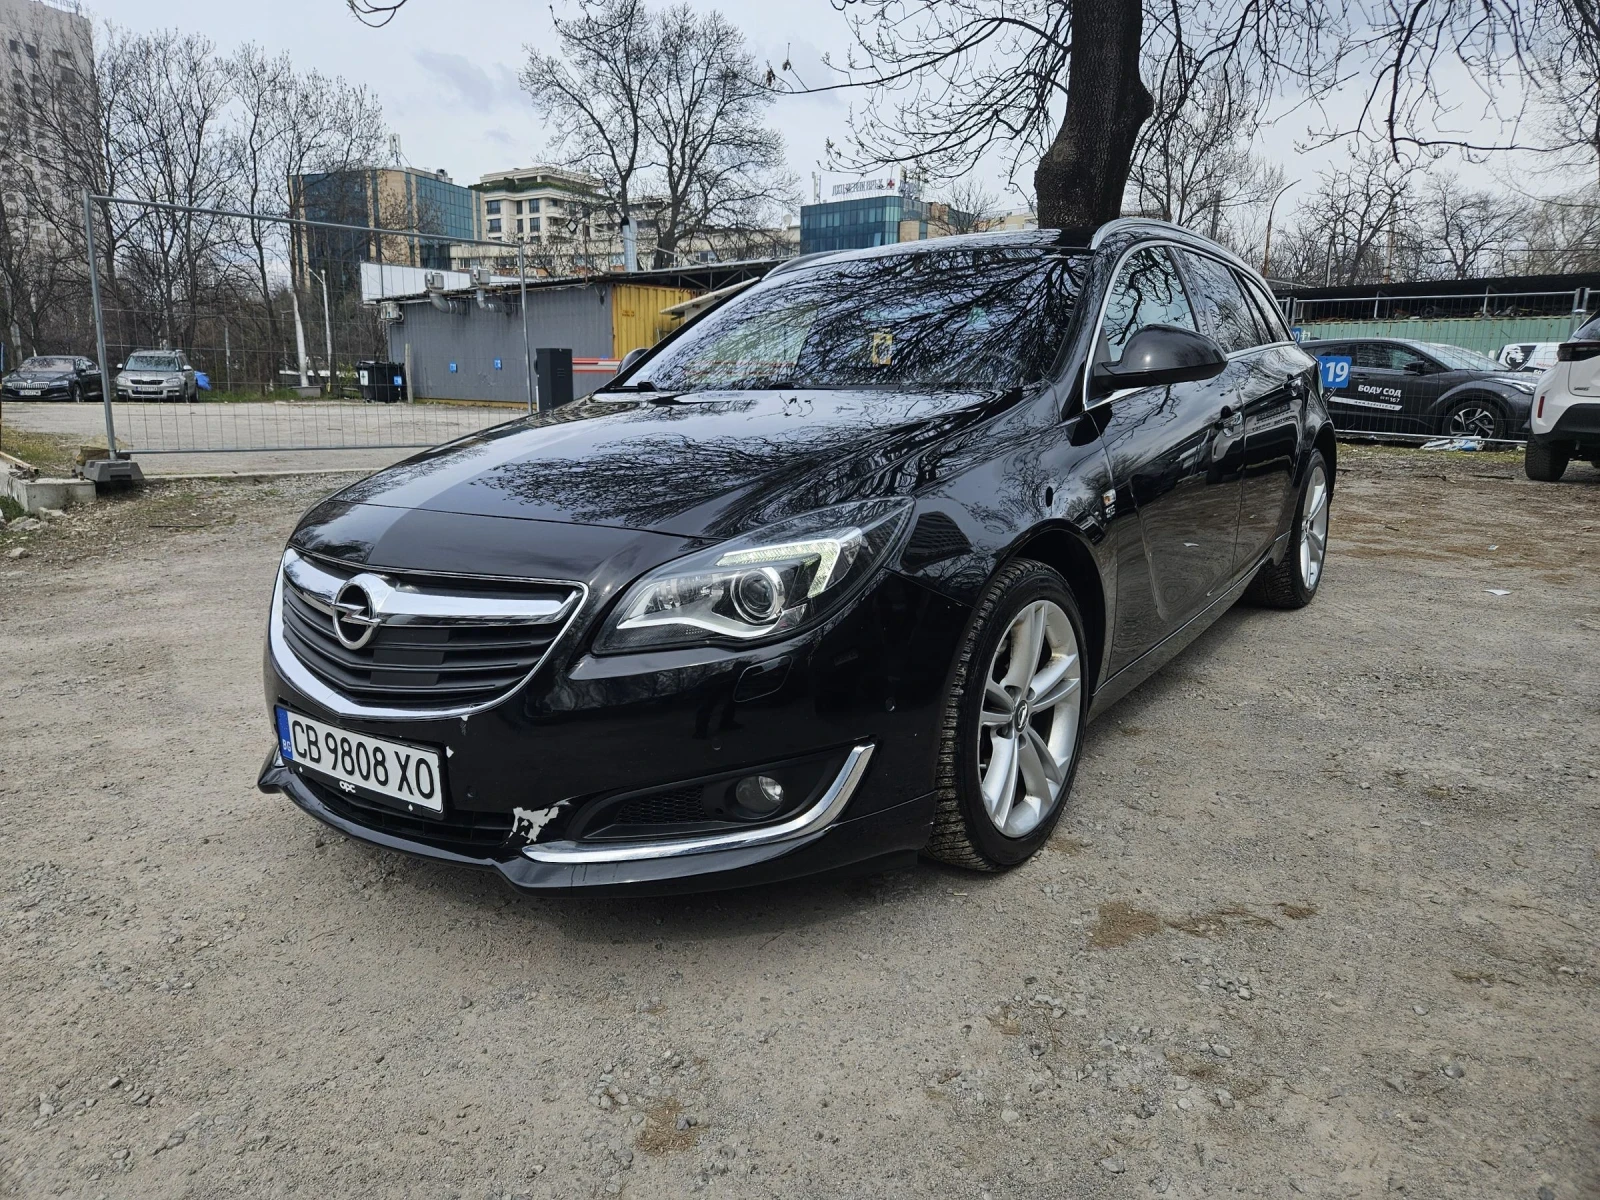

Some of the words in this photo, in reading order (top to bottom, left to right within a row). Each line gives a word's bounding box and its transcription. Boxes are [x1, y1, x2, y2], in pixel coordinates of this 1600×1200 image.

[1326, 361, 1349, 383] 19
[1358, 384, 1382, 394] БОДУ
[1382, 388, 1402, 398] СОД
[282, 738, 292, 752] BG
[324, 731, 389, 787] 9808
